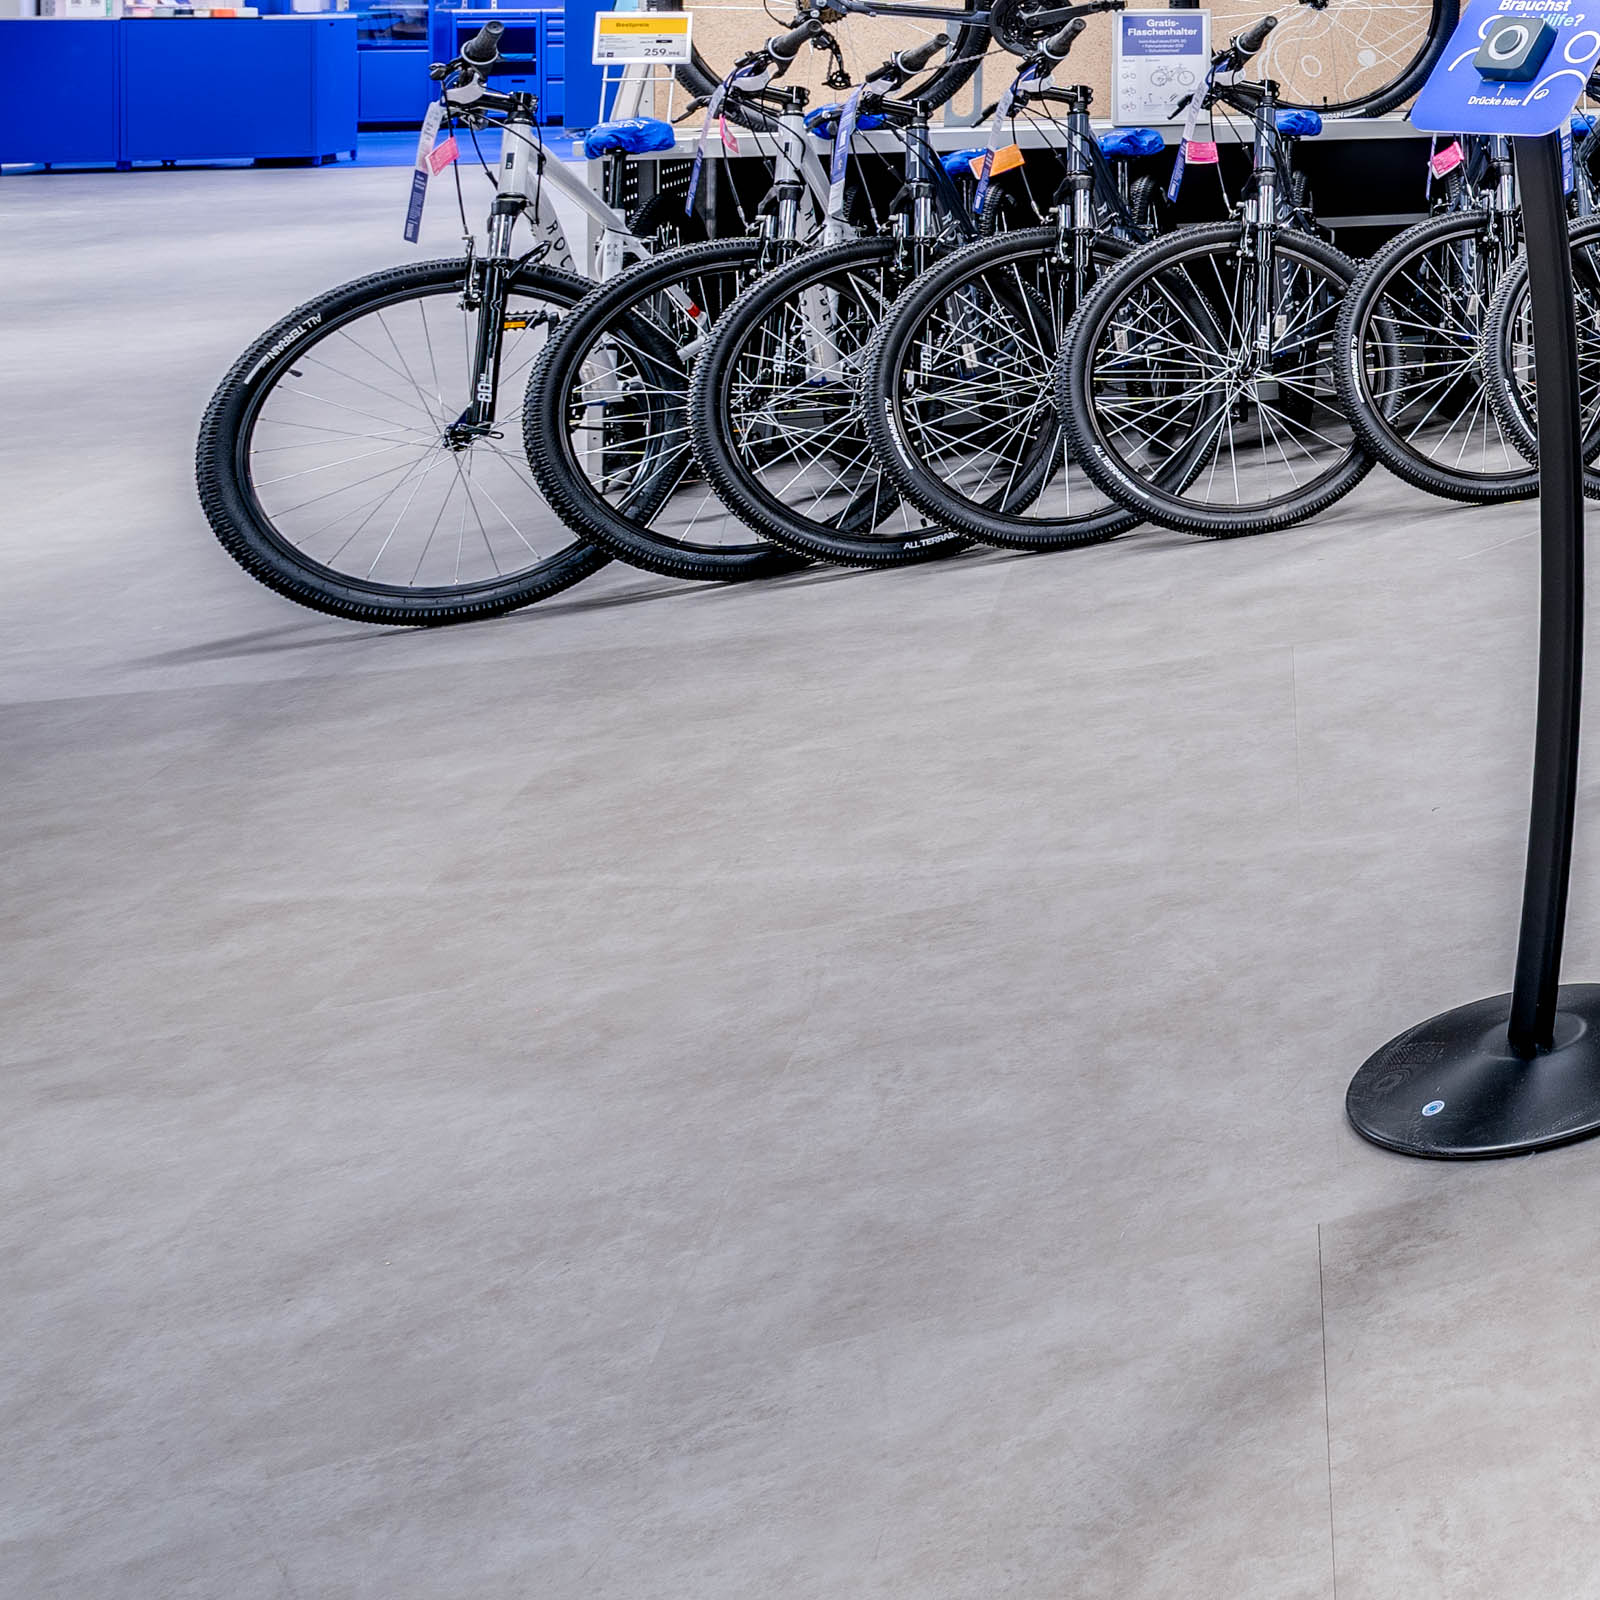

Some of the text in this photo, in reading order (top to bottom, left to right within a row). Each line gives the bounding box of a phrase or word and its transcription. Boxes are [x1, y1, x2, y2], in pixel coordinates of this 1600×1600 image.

[1146, 19, 1179, 27] Gratis-
[1128, 28, 1198, 36] Flaschenhalter
[1468, 96, 1522, 106] Drücke hier
[269, 313, 322, 360] ALL TERRAIN
[903, 540, 920, 550] ALL
